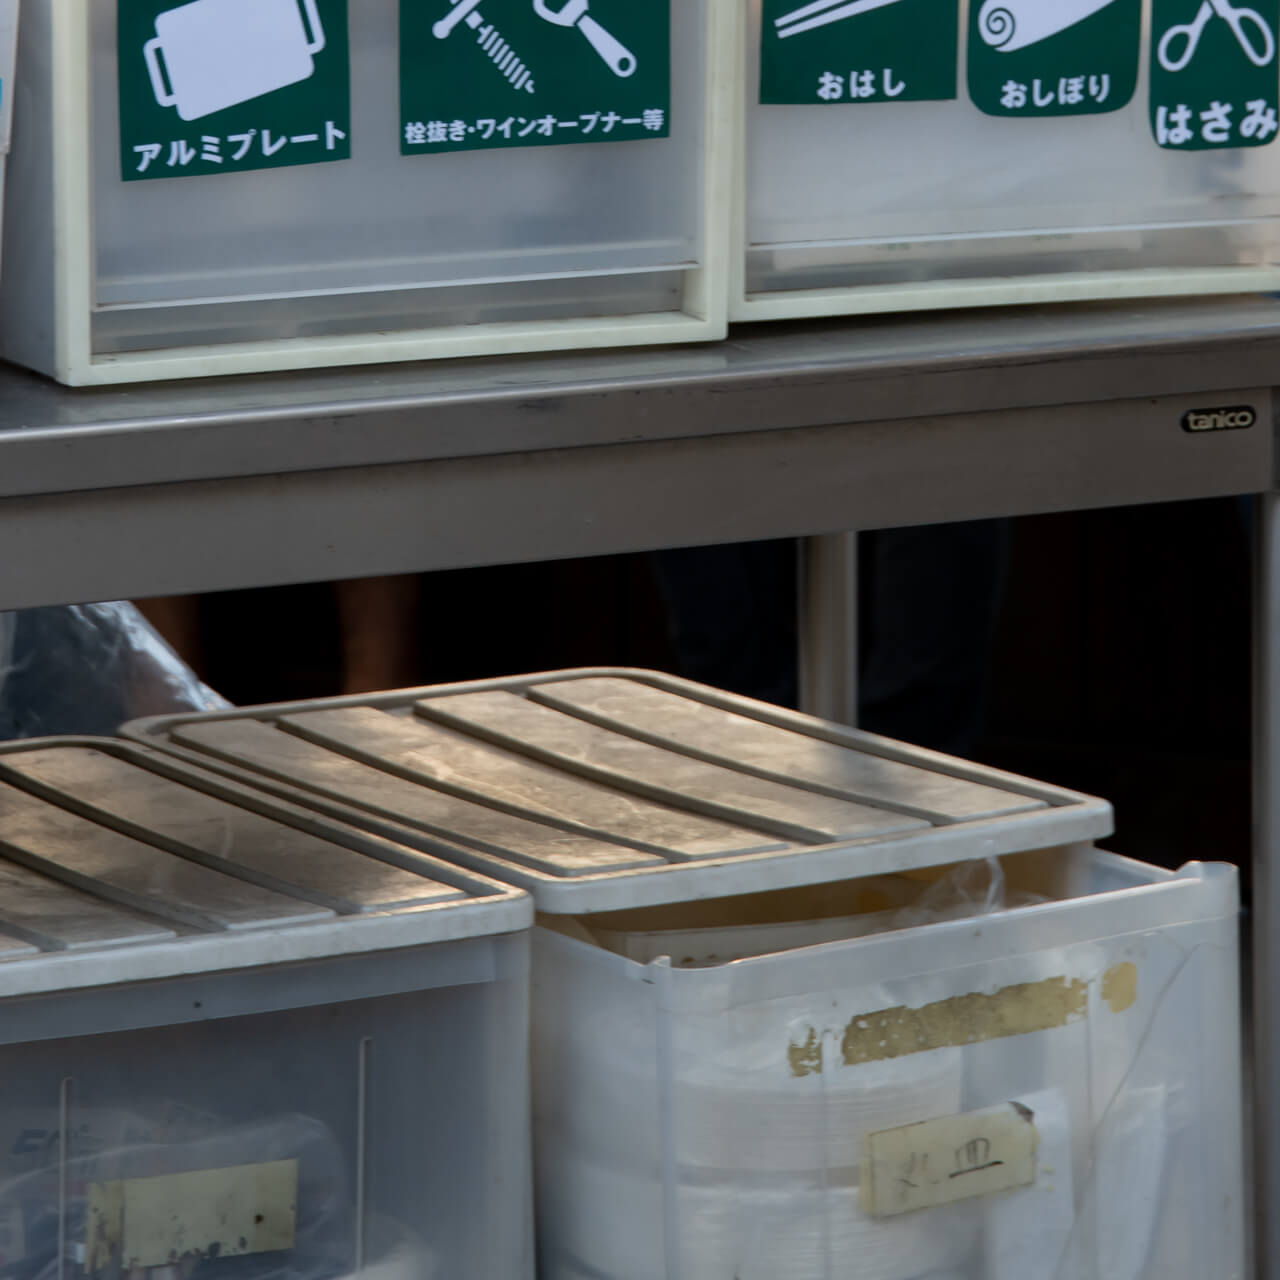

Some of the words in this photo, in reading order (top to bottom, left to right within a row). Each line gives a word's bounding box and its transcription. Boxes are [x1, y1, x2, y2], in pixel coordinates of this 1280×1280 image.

[817, 69, 906, 100] おはし
[1000, 74, 1111, 109] おしぼり
[1156, 99, 1278, 145] はさみ
[133, 120, 347, 172] アルミプレート
[1187, 410, 1254, 430] tanico
